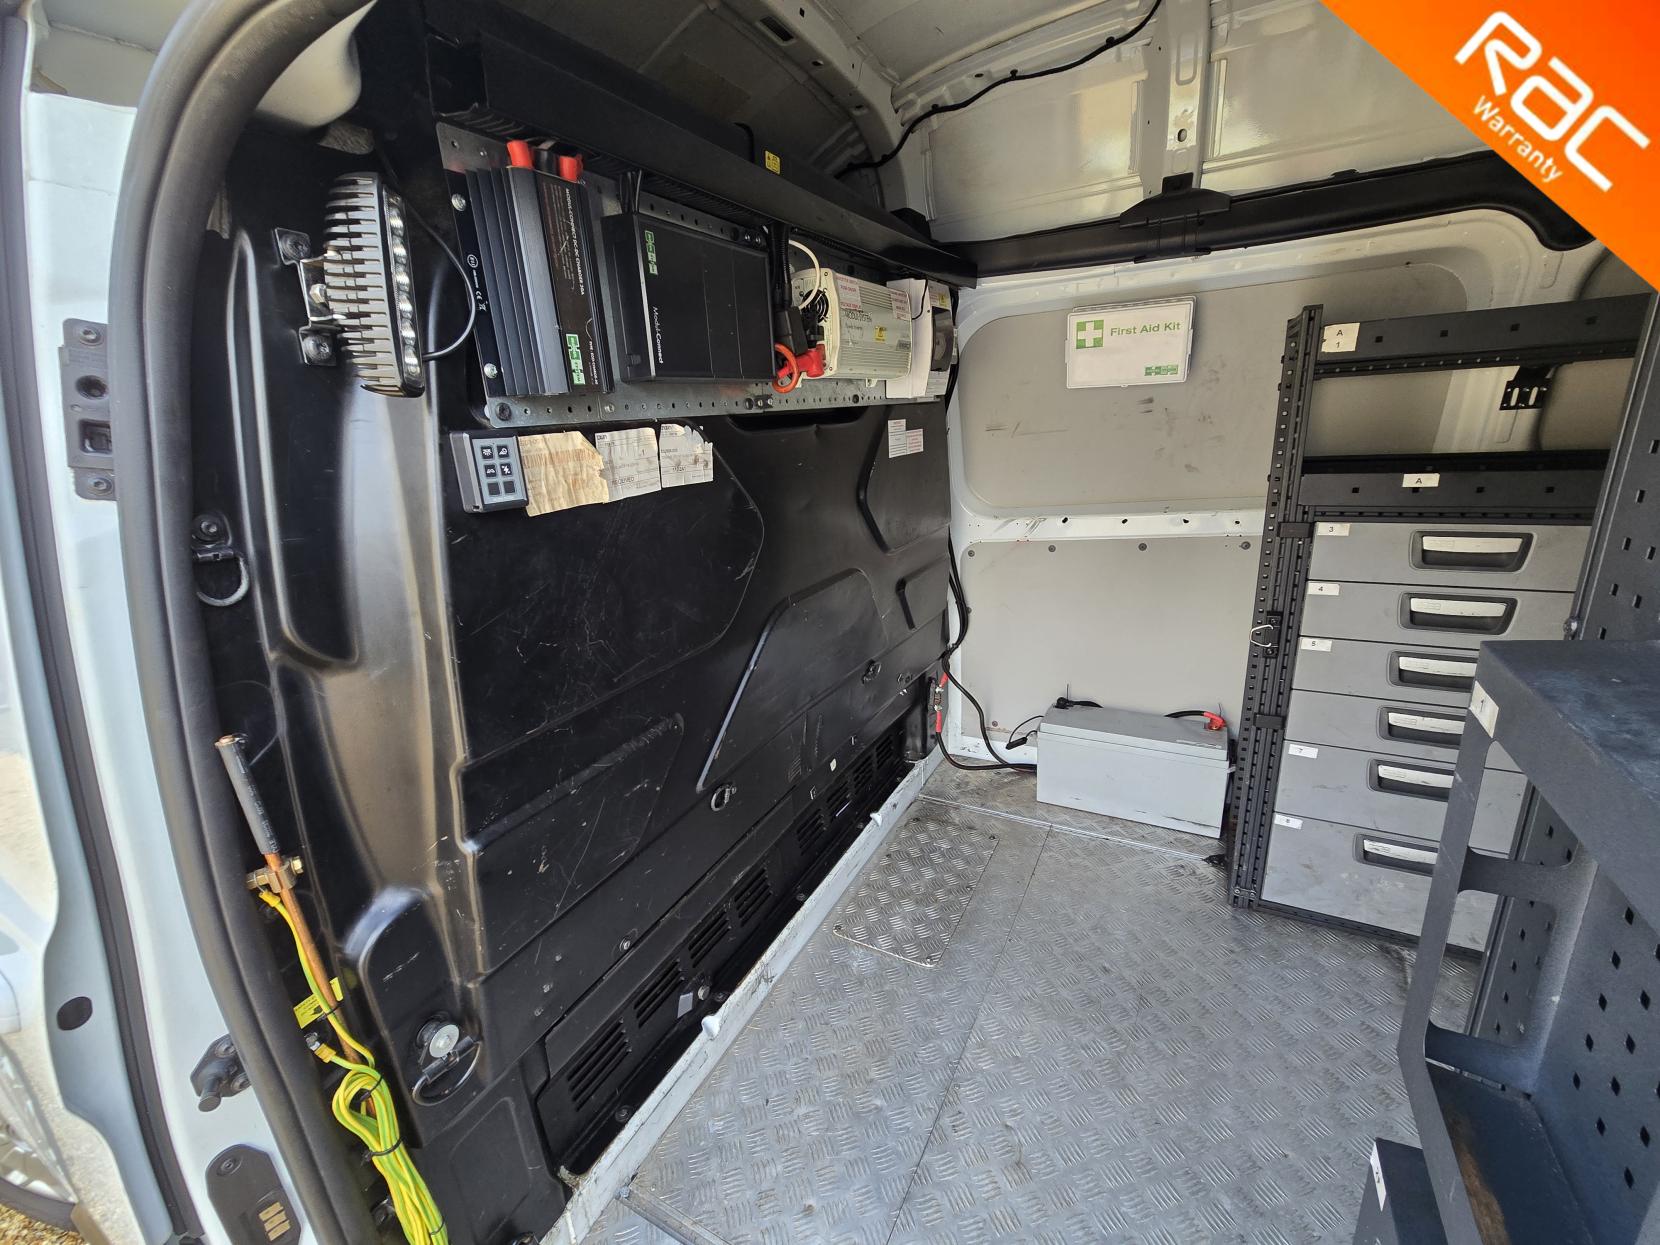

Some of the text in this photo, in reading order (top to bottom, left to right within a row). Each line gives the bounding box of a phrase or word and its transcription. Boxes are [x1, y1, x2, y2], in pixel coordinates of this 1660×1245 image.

[1110, 322, 1182, 337] First Aid Kit
